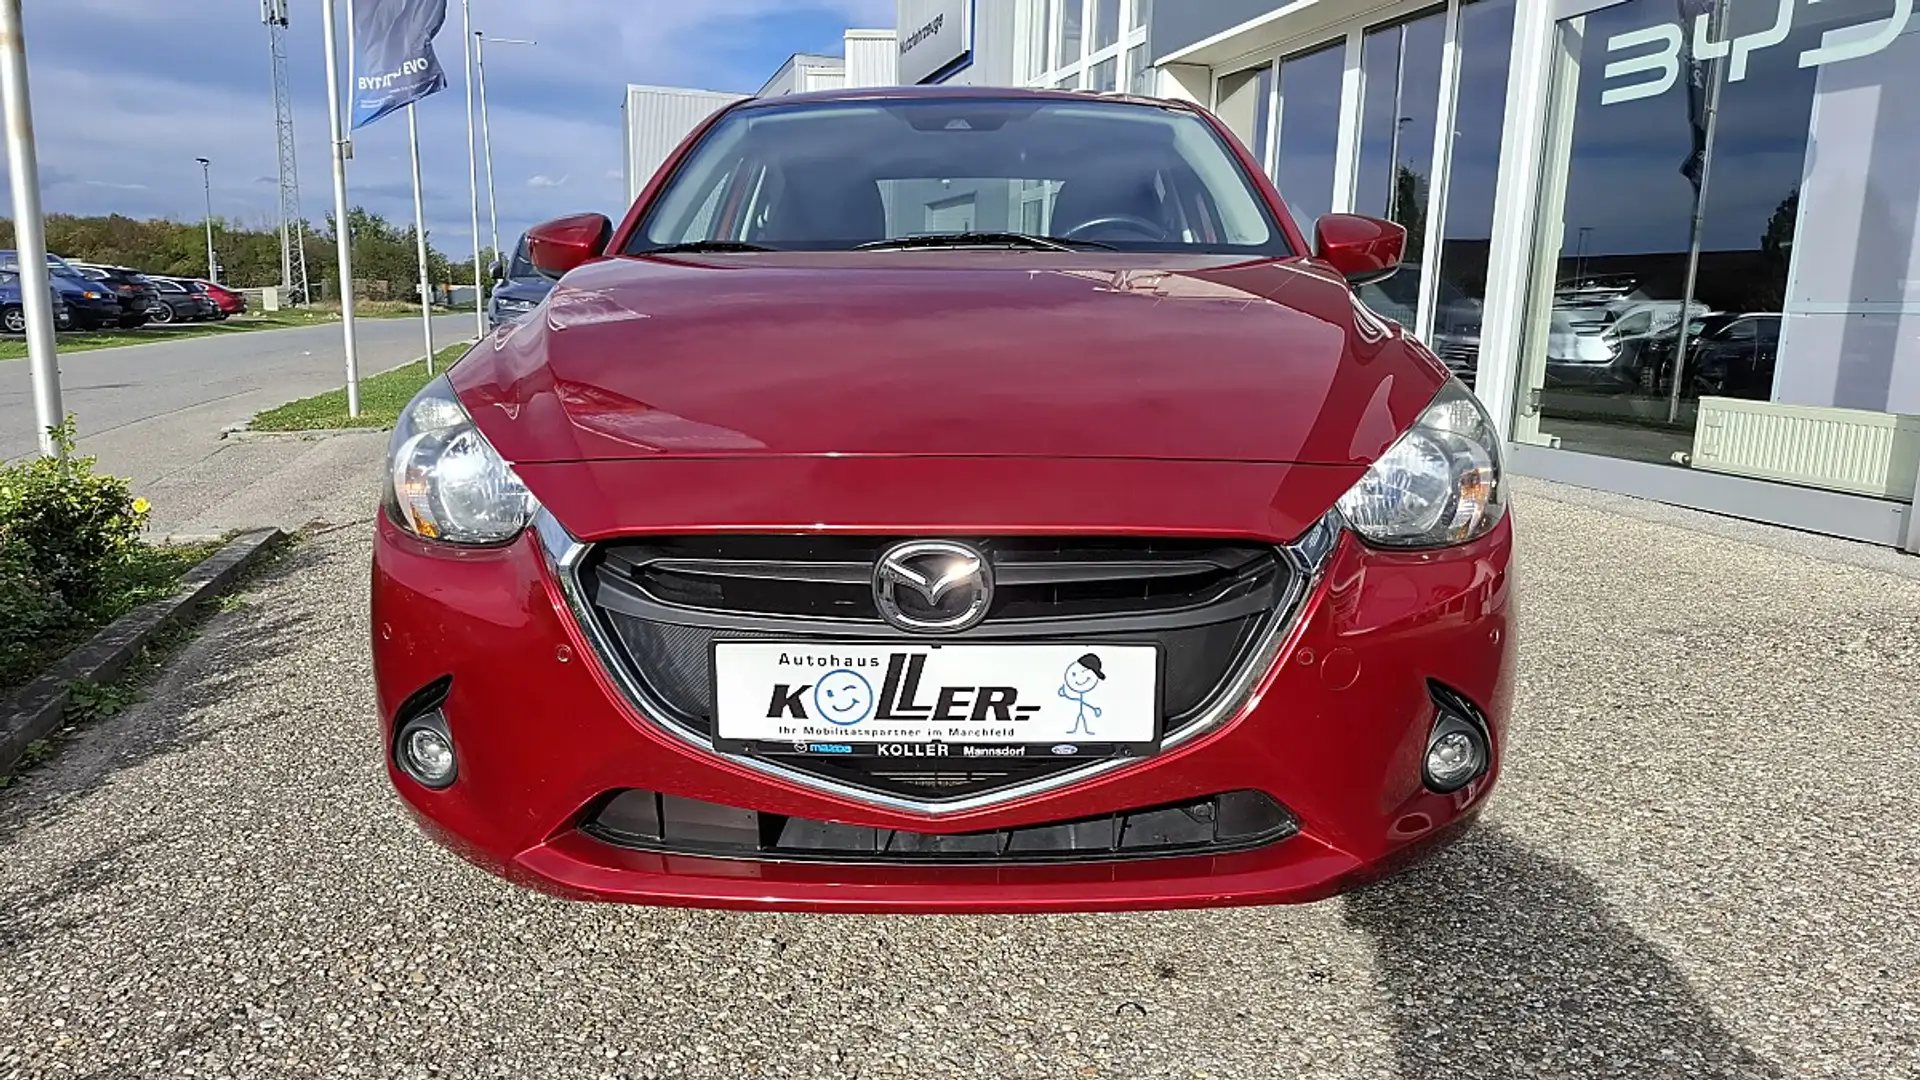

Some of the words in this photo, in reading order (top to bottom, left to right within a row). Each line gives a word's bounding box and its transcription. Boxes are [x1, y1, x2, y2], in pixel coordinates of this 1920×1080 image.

[1602, 0, 1912, 105] BYD
[778, 652, 880, 667] Autohaus
[778, 726, 797, 735] Ihr
[927, 728, 943, 736] im
[948, 727, 1015, 737] Marchfeld
[877, 743, 949, 756] KOLLER
[963, 745, 1026, 757] Mannsdorf
